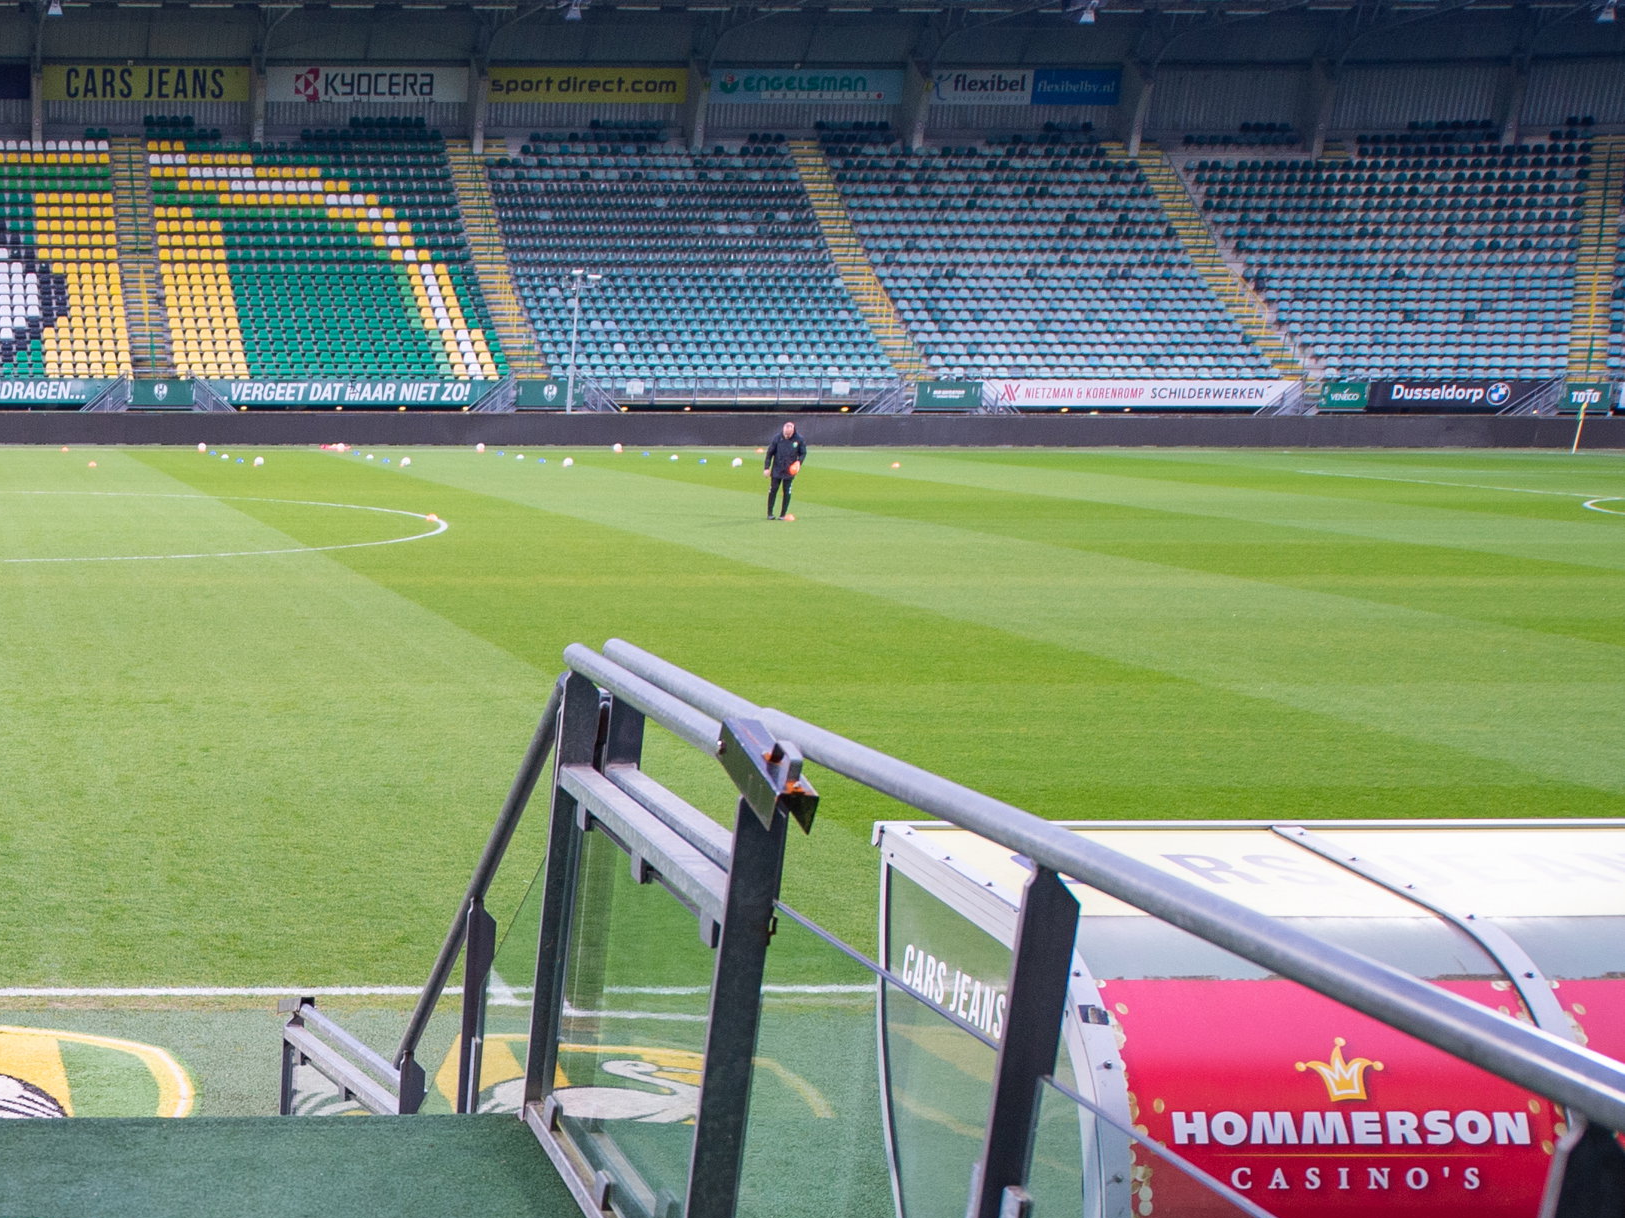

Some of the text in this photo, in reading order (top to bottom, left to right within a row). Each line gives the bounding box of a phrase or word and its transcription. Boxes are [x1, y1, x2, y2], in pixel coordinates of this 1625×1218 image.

[65, 68, 224, 99] CARS JEANS
[324, 73, 434, 96] KYOCERA
[953, 73, 1026, 92] flexibel
[0, 381, 86, 400] DRAGEN...
[308, 382, 344, 401] DAT
[344, 382, 396, 401] MAAR
[398, 383, 441, 401] NIET
[440, 383, 471, 401] ZO!
[1025, 387, 1074, 399] NIETZMAN
[1085, 387, 1145, 399] KORENROMP
[1150, 388, 1264, 399] SCHILDERWERKEN
[1391, 384, 1485, 403] Dusseldorp
[1571, 389, 1602, 403] TOTO
[902, 944, 1007, 1039] CARS JEANS
[1170, 1110, 1532, 1146] HOMMERSON
[1231, 1166, 1481, 1191] CASINO'S
